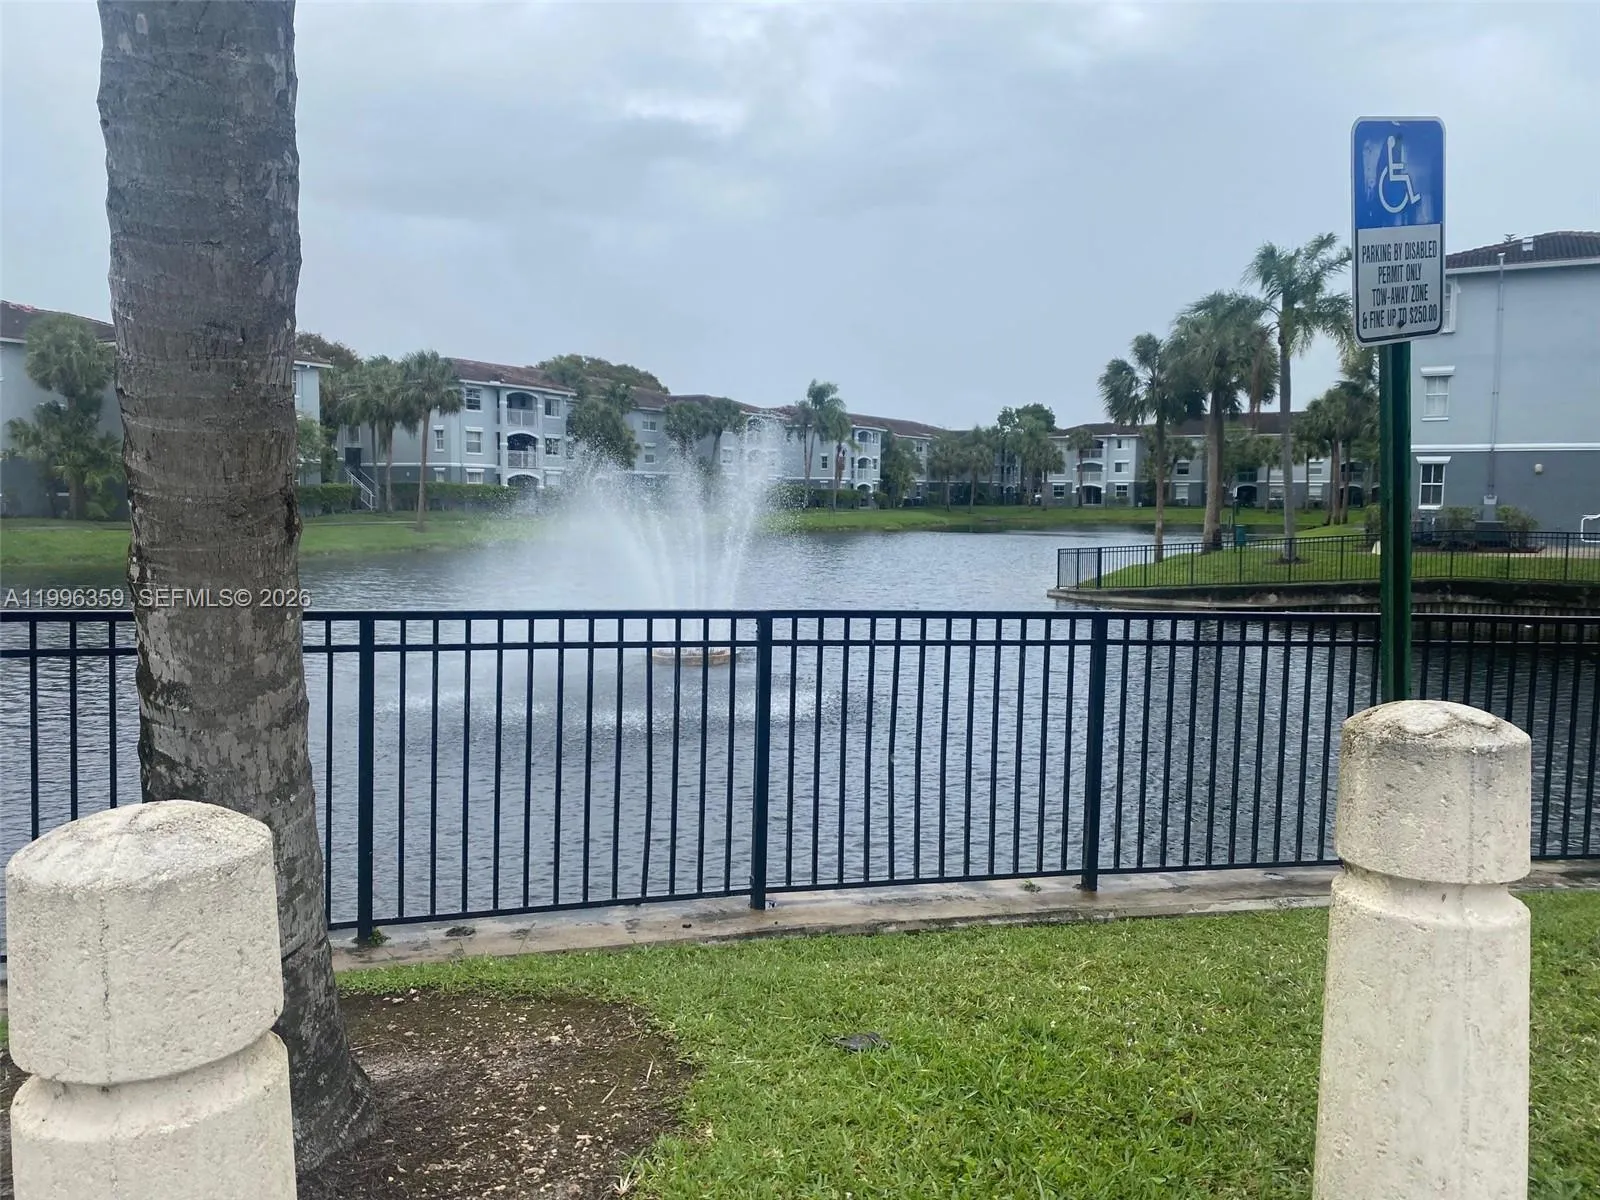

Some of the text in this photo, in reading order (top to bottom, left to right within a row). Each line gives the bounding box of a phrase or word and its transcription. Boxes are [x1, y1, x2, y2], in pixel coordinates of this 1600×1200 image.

[1362, 240, 1437, 264] PARKING BY DISABLED
[1378, 263, 1422, 284] PERMIT ONLY
[1372, 284, 1428, 307] TOW-AWAY ZONE
[1362, 304, 1437, 329] & FINE UP TO $250.00
